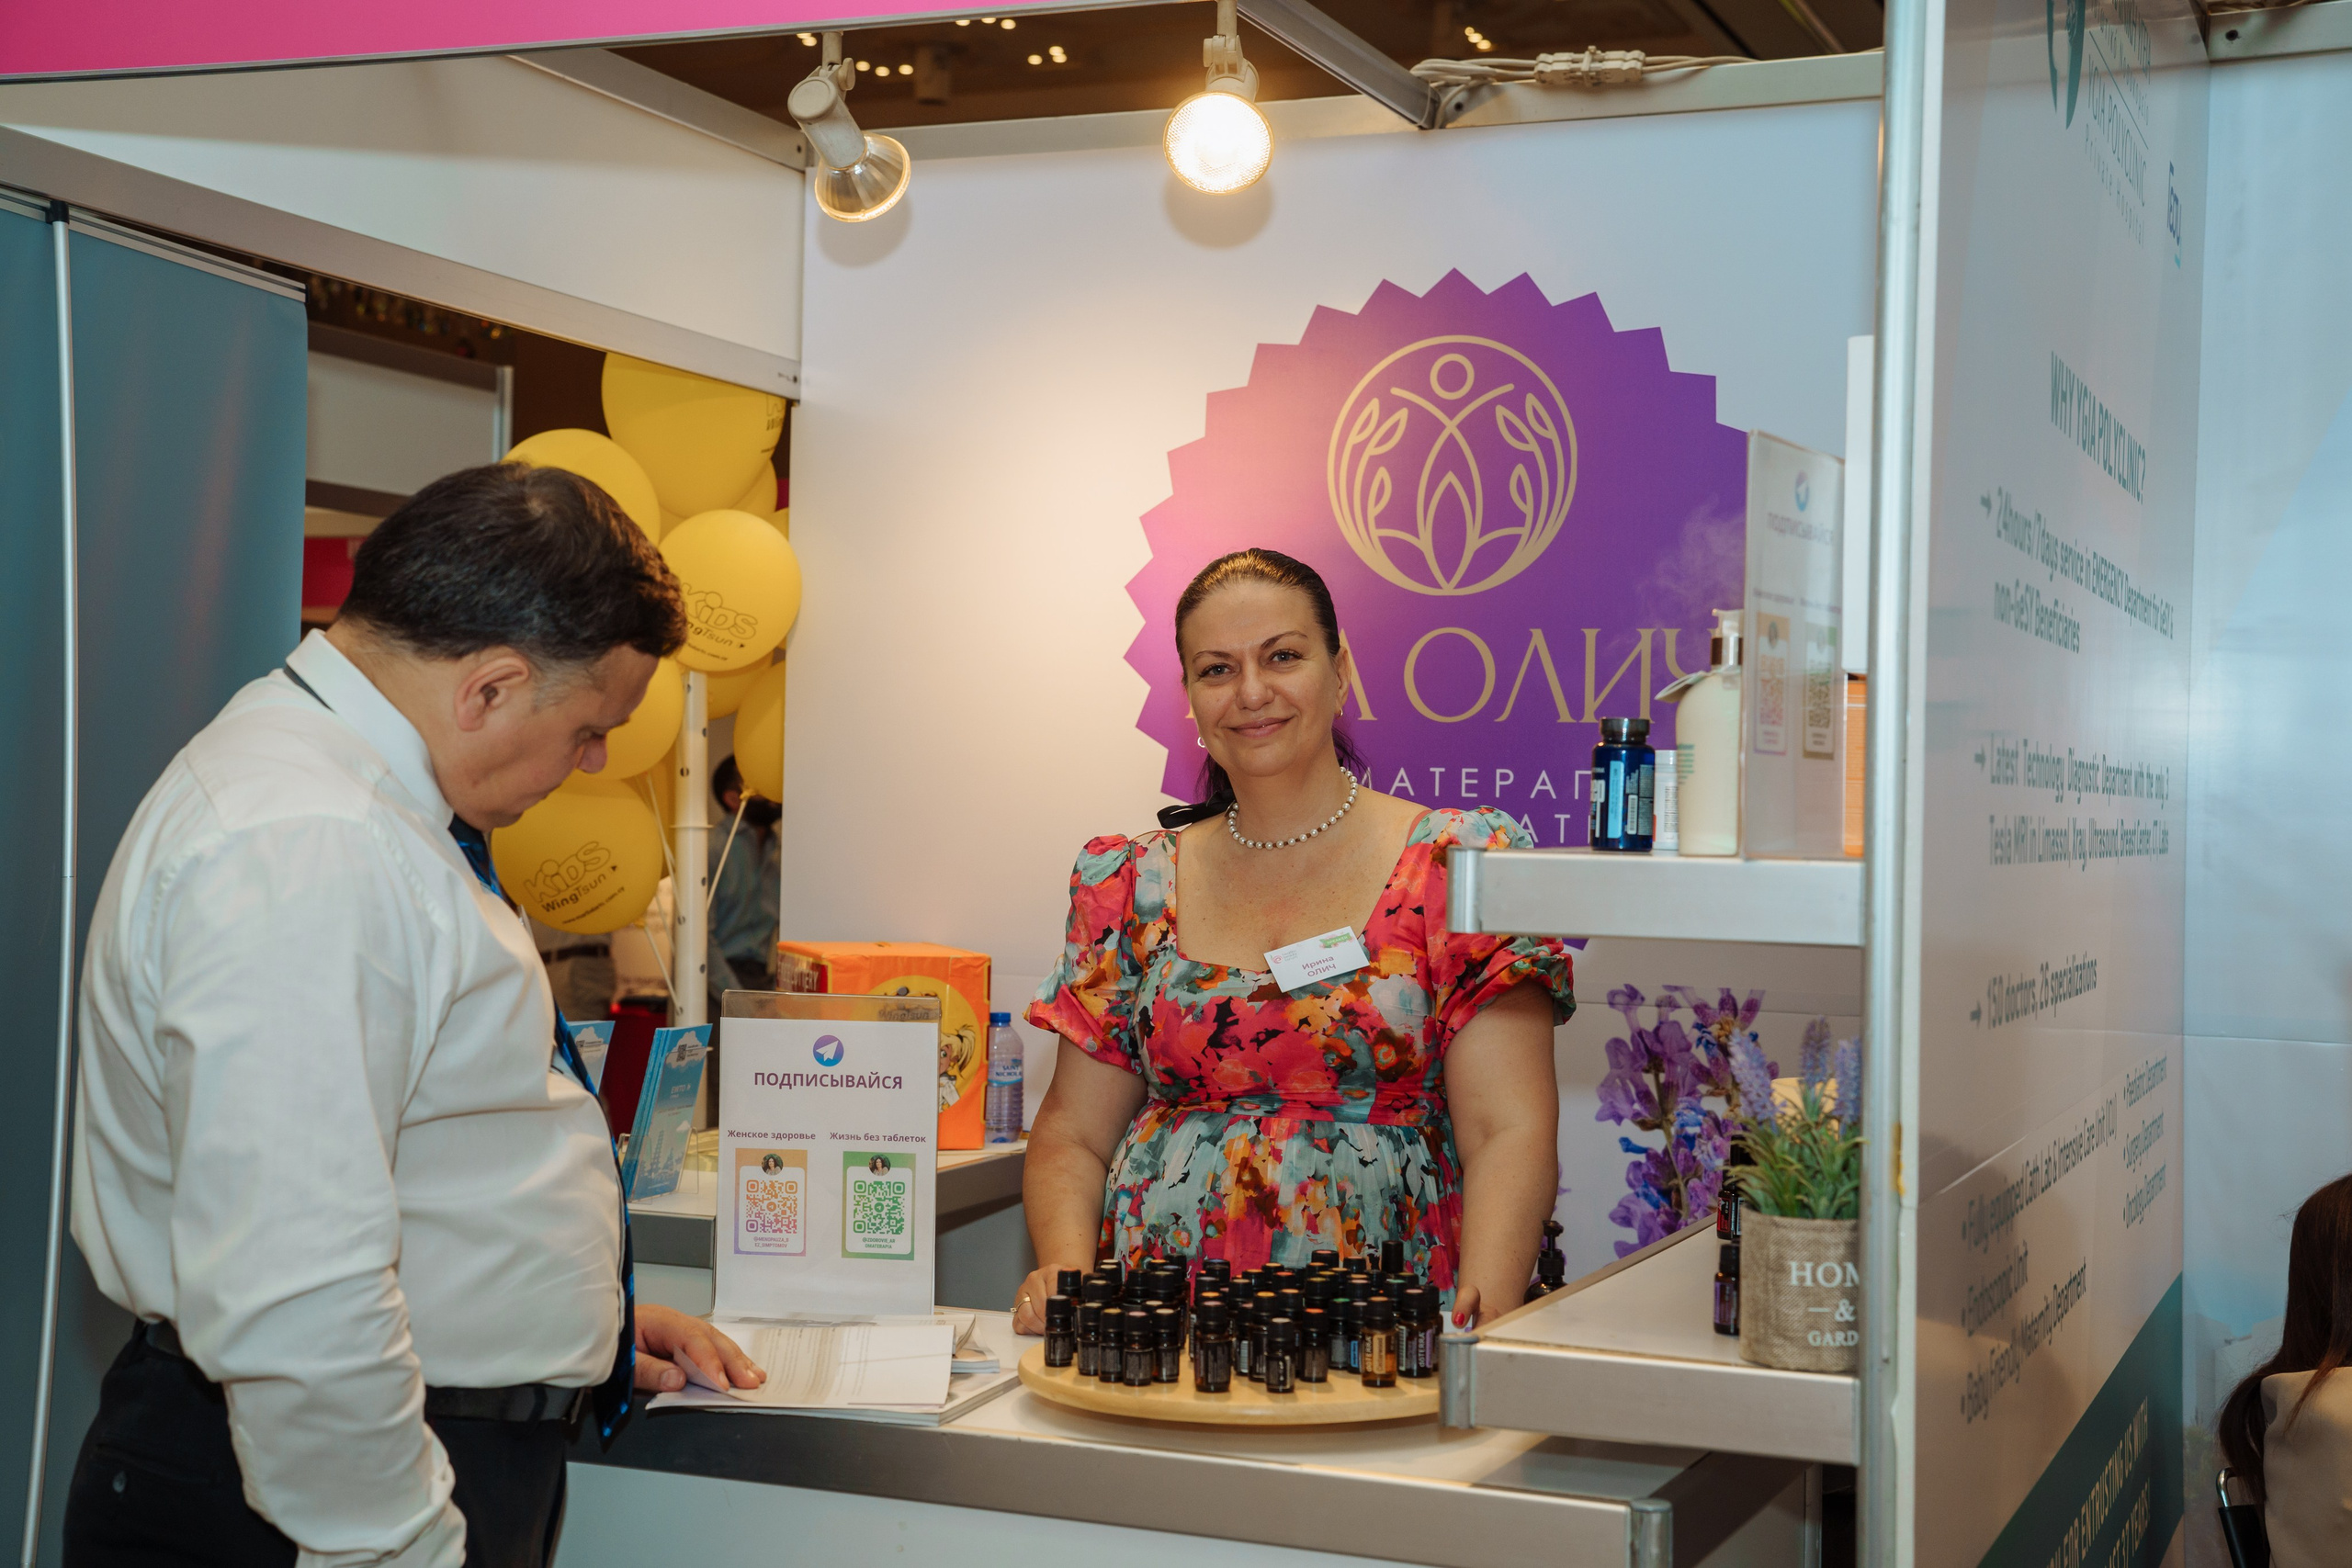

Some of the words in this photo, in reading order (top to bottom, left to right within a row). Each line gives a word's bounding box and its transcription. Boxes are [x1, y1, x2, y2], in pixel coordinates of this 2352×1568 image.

[2087, 54, 2106, 134] YGIA
[2108, 95, 2147, 207] POLYCLINIC
[2085, 124, 2112, 196] Private
[2116, 177, 2144, 248] Hospital
[2051, 350, 2075, 438] WHY
[2076, 378, 2096, 462] YGIA
[2098, 400, 2146, 505] POLYCLINIC?
[2060, 538, 2084, 586] service
[2085, 546, 2091, 592] in
[2092, 550, 2124, 611] EMERGENCY
[2124, 573, 2152, 626] Department
[687, 621, 733, 647] ngTsun
[2035, 589, 2080, 654] Beneficiaries
[1990, 733, 2018, 784] Latest
[2023, 738, 2064, 804] Technology
[2068, 746, 2099, 805] Diagnostic
[2102, 753, 2132, 807] Department
[1989, 815, 2012, 865] Tesla
[2013, 816, 2029, 863] MRI
[2030, 816, 2036, 863] in
[2120, 818, 2136, 857] Breast
[541, 874, 606, 913] WingTsun
[1302, 956, 1334, 970] Ирина
[1307, 964, 1336, 977] ОЛИЧ
[1987, 974, 2004, 1030] 150
[2005, 973, 2038, 1021] doctors,
[2040, 961, 2050, 1010] 26
[2051, 950, 2098, 1019] specializations
[753, 1071, 903, 1090] ПОДПИСЫВАЙСЯ
[727, 1129, 769, 1140] Женское
[770, 1131, 817, 1142] здоровье
[830, 1131, 862, 1142] Жизнь
[864, 1132, 880, 1143] без
[882, 1133, 926, 1144] таблеток
[1968, 1193, 1989, 1254] Fully
[1990, 1163, 2024, 1243] equipped
[2025, 1154, 2040, 1206] Cath
[2041, 1145, 2052, 1194] Lab
[2057, 1124, 2083, 1180] Intensive
[2083, 1117, 2095, 1158] Care
[2096, 1106, 2106, 1148] Unit
[1789, 1260, 1860, 1287] HOM
[2014, 1239, 2029, 1293] Unit
[1834, 1298, 1856, 1323] &
[1807, 1330, 1859, 1348] GARD
[1967, 1362, 1989, 1425] Baby
[1989, 1326, 2020, 1402] Friendly
[2020, 1295, 2052, 1364] Maternity
[2052, 1256, 2086, 1332] Department
[2081, 1439, 2124, 1562] ENTRUSTING
[2124, 1423, 2132, 1478] US
[2132, 1395, 2148, 1461] WITH
